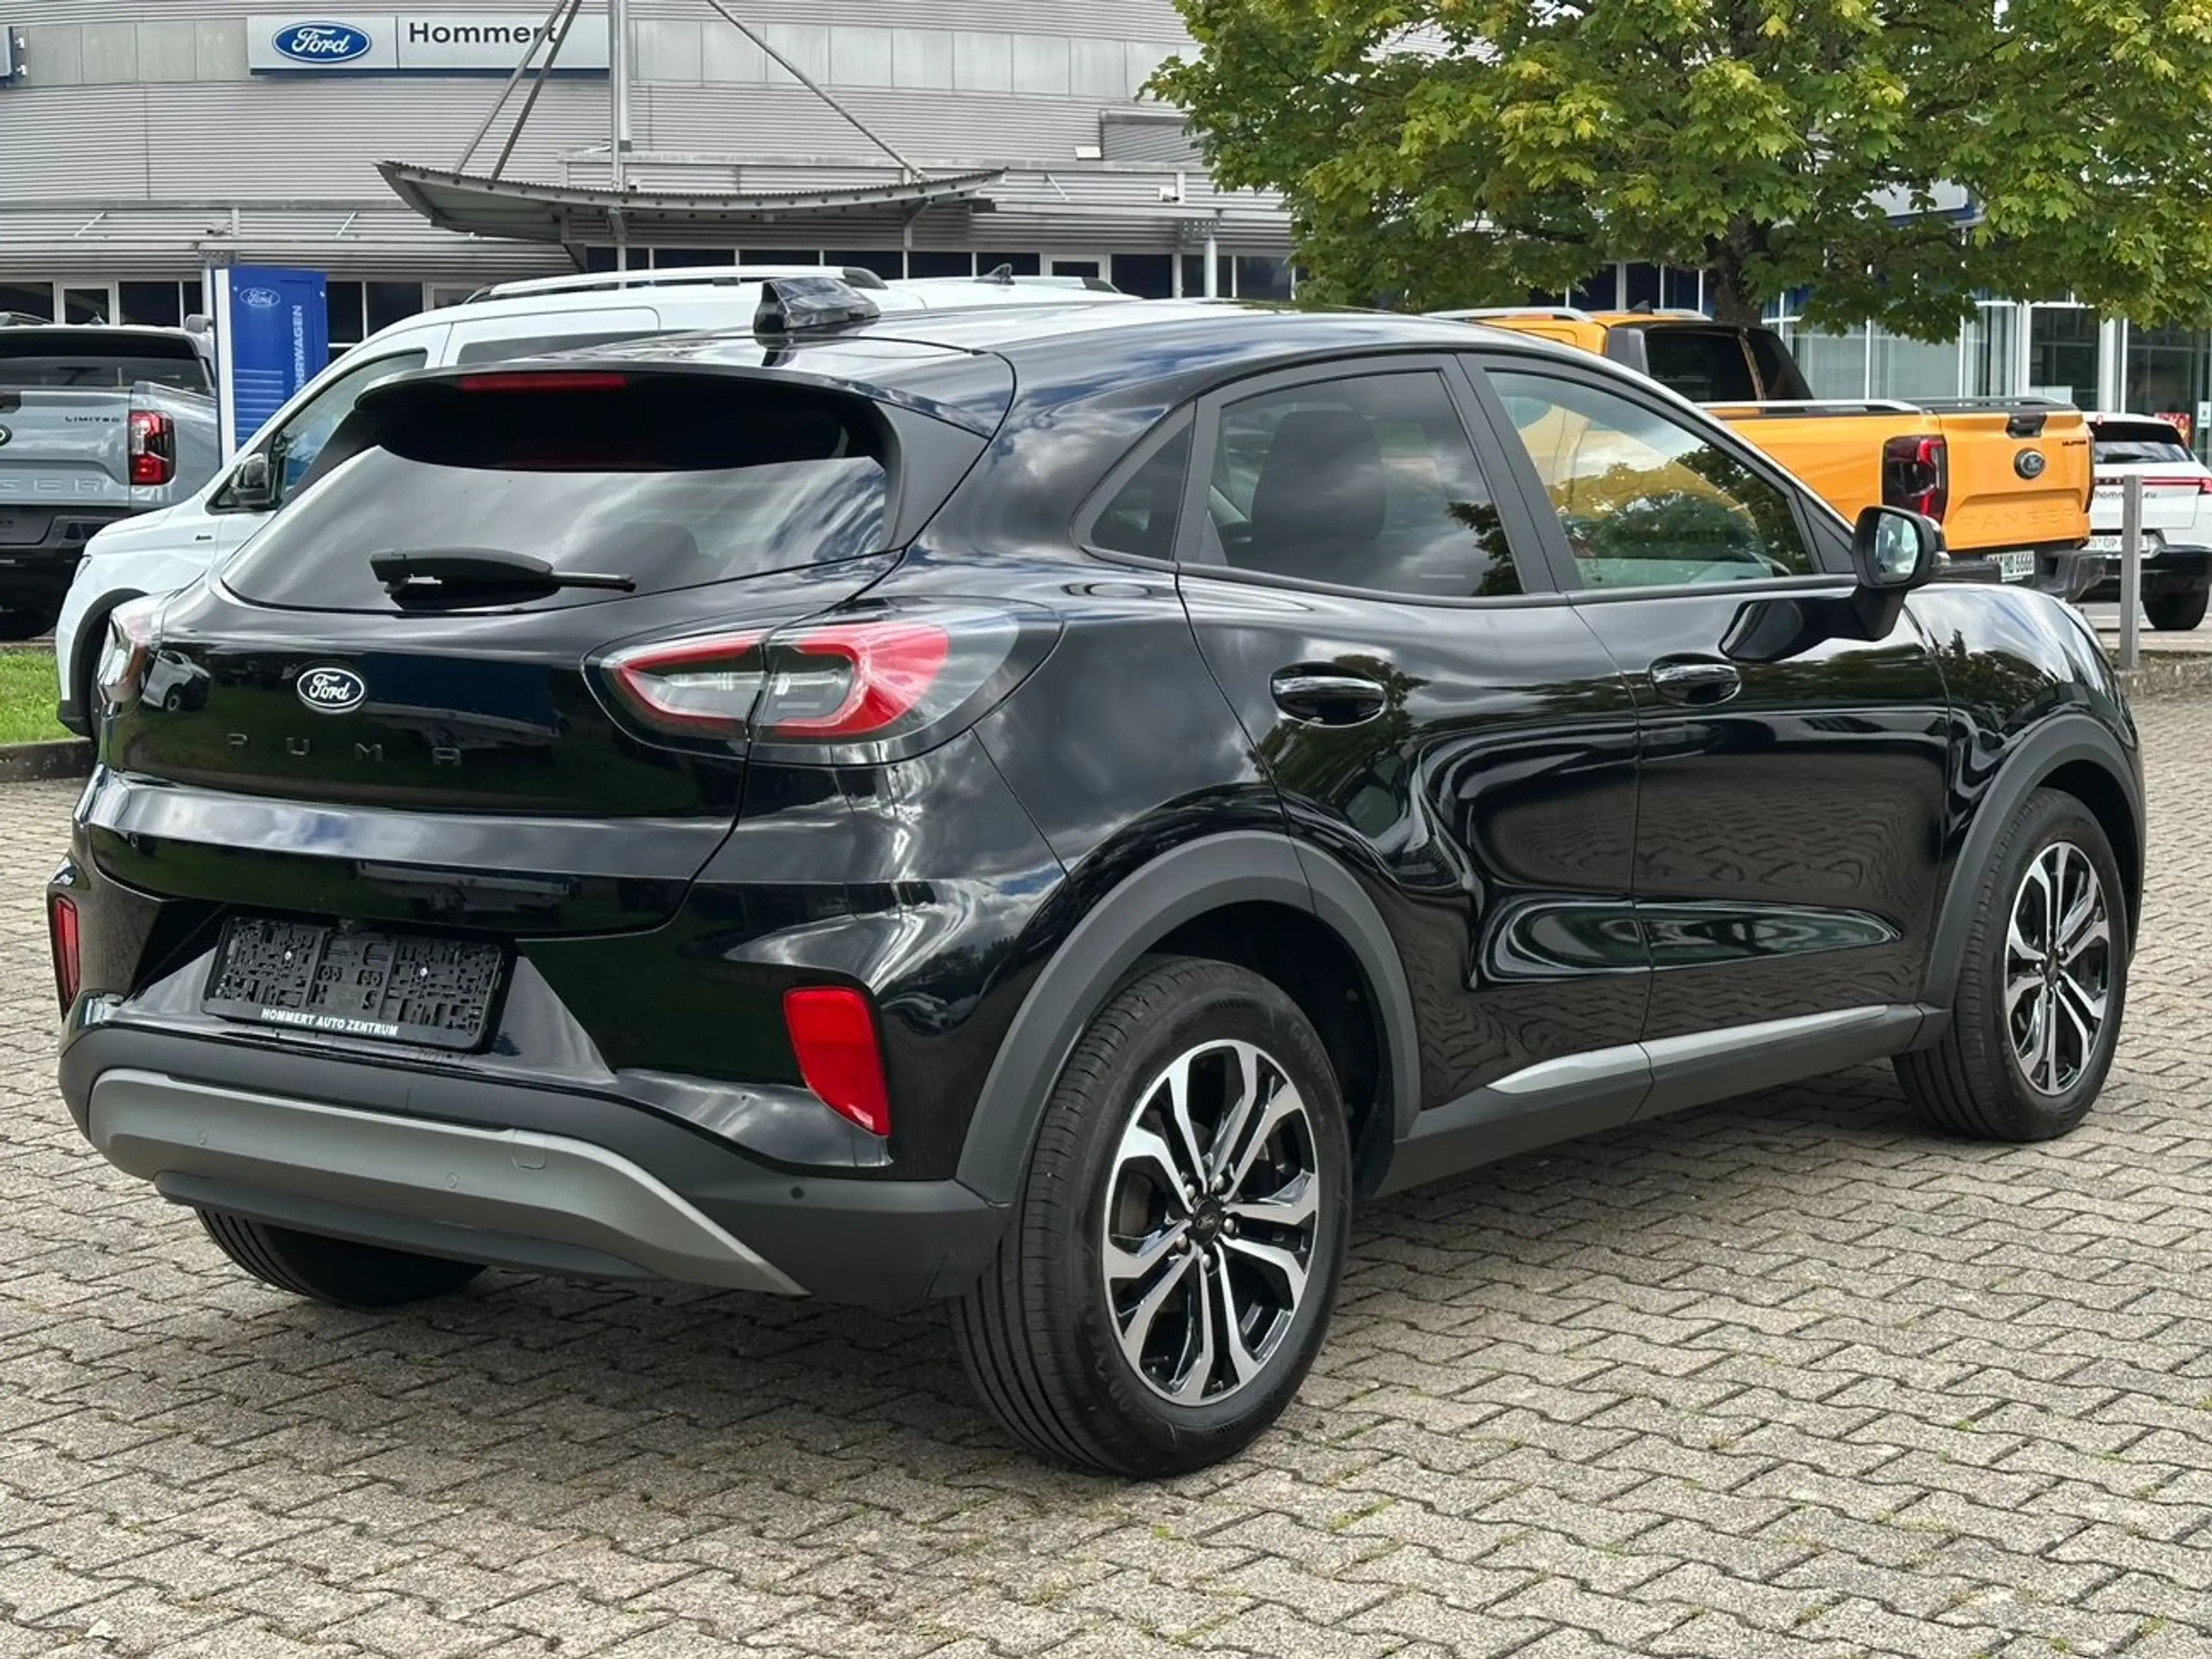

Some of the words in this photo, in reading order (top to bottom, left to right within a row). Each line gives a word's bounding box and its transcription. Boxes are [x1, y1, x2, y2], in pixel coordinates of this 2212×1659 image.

[291, 27, 351, 54] Ford
[410, 22, 558, 43] Hommert
[309, 673, 350, 700] Ford
[229, 733, 461, 765] PUMA
[261, 1008, 316, 1025] HOMMERT
[316, 1016, 345, 1030] AUTO
[346, 1019, 399, 1036] ZENTRUM
